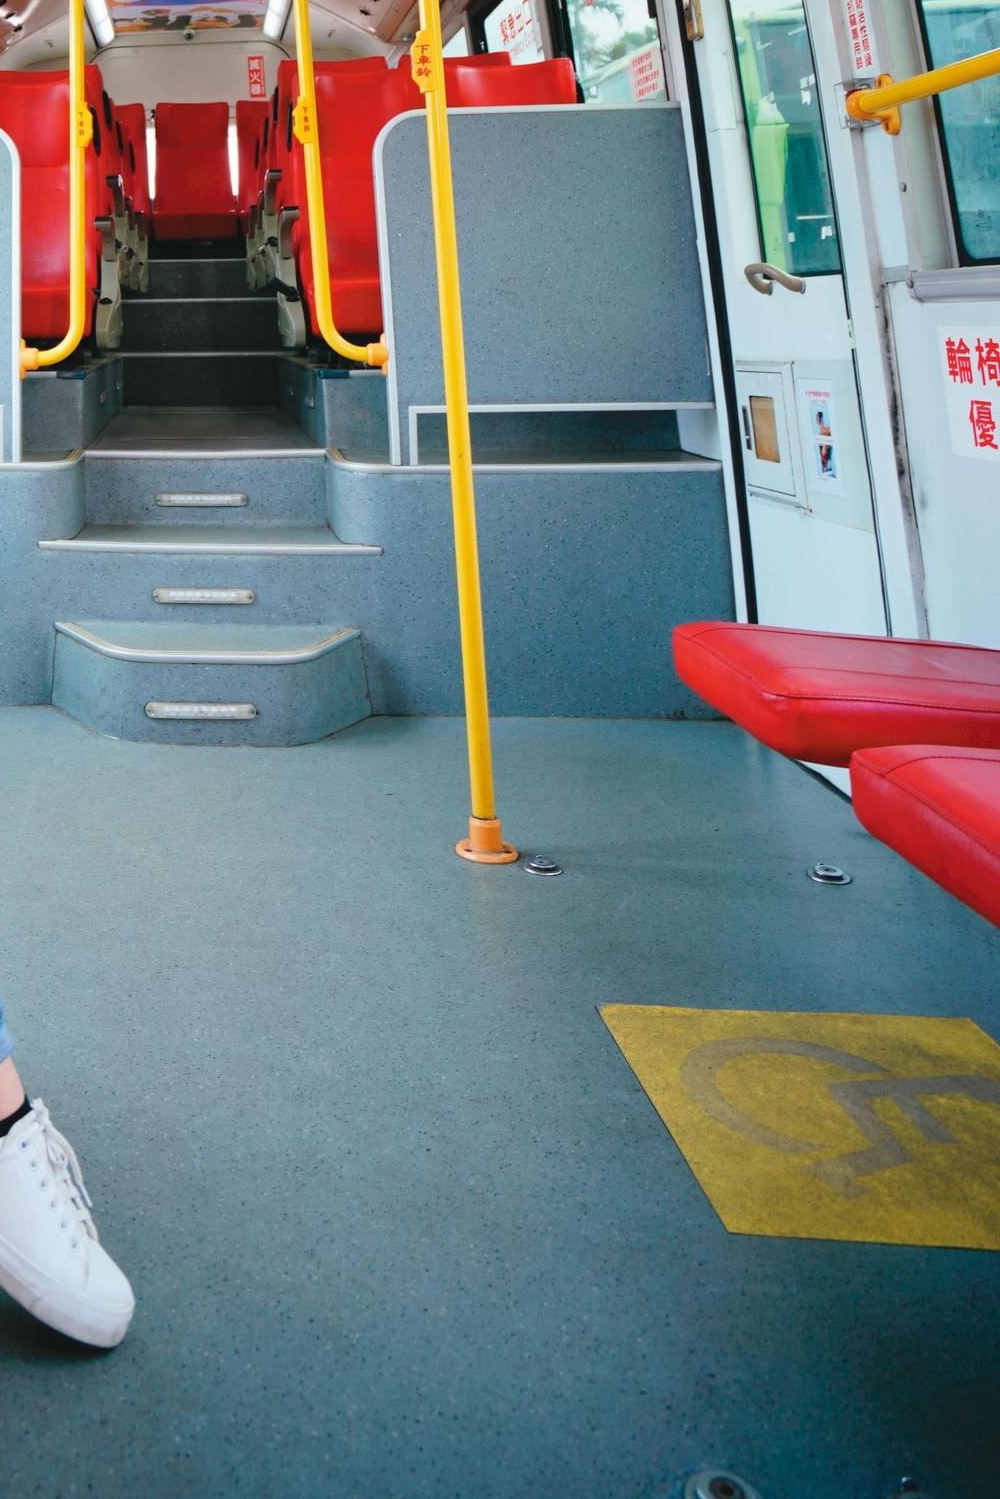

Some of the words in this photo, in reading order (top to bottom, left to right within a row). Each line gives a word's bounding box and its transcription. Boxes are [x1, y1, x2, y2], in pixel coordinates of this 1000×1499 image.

[415, 45, 432, 78] 下車鈴
[969, 399, 999, 450] 優
